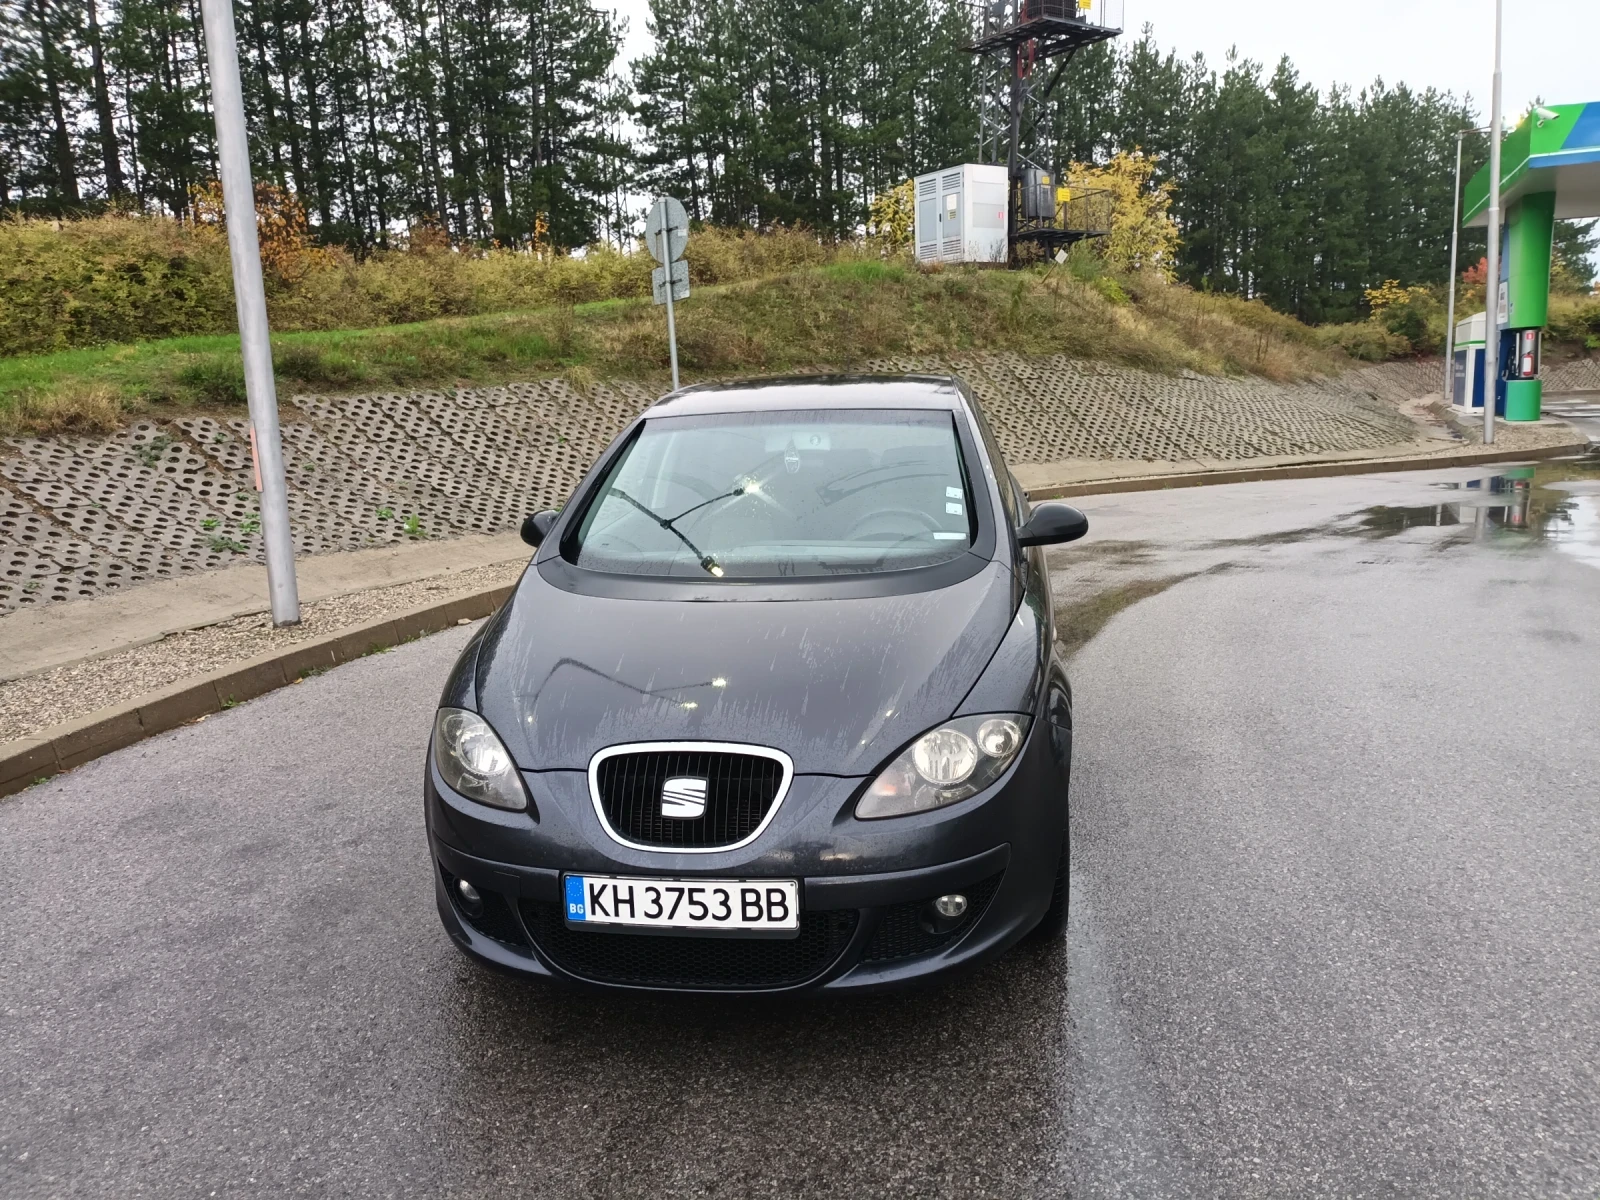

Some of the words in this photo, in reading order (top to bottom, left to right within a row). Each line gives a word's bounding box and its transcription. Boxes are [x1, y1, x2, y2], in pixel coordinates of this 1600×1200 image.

[569, 903, 585, 914] BG
[589, 883, 635, 919] KH
[644, 886, 732, 922] 3753
[741, 888, 789, 922] BB
